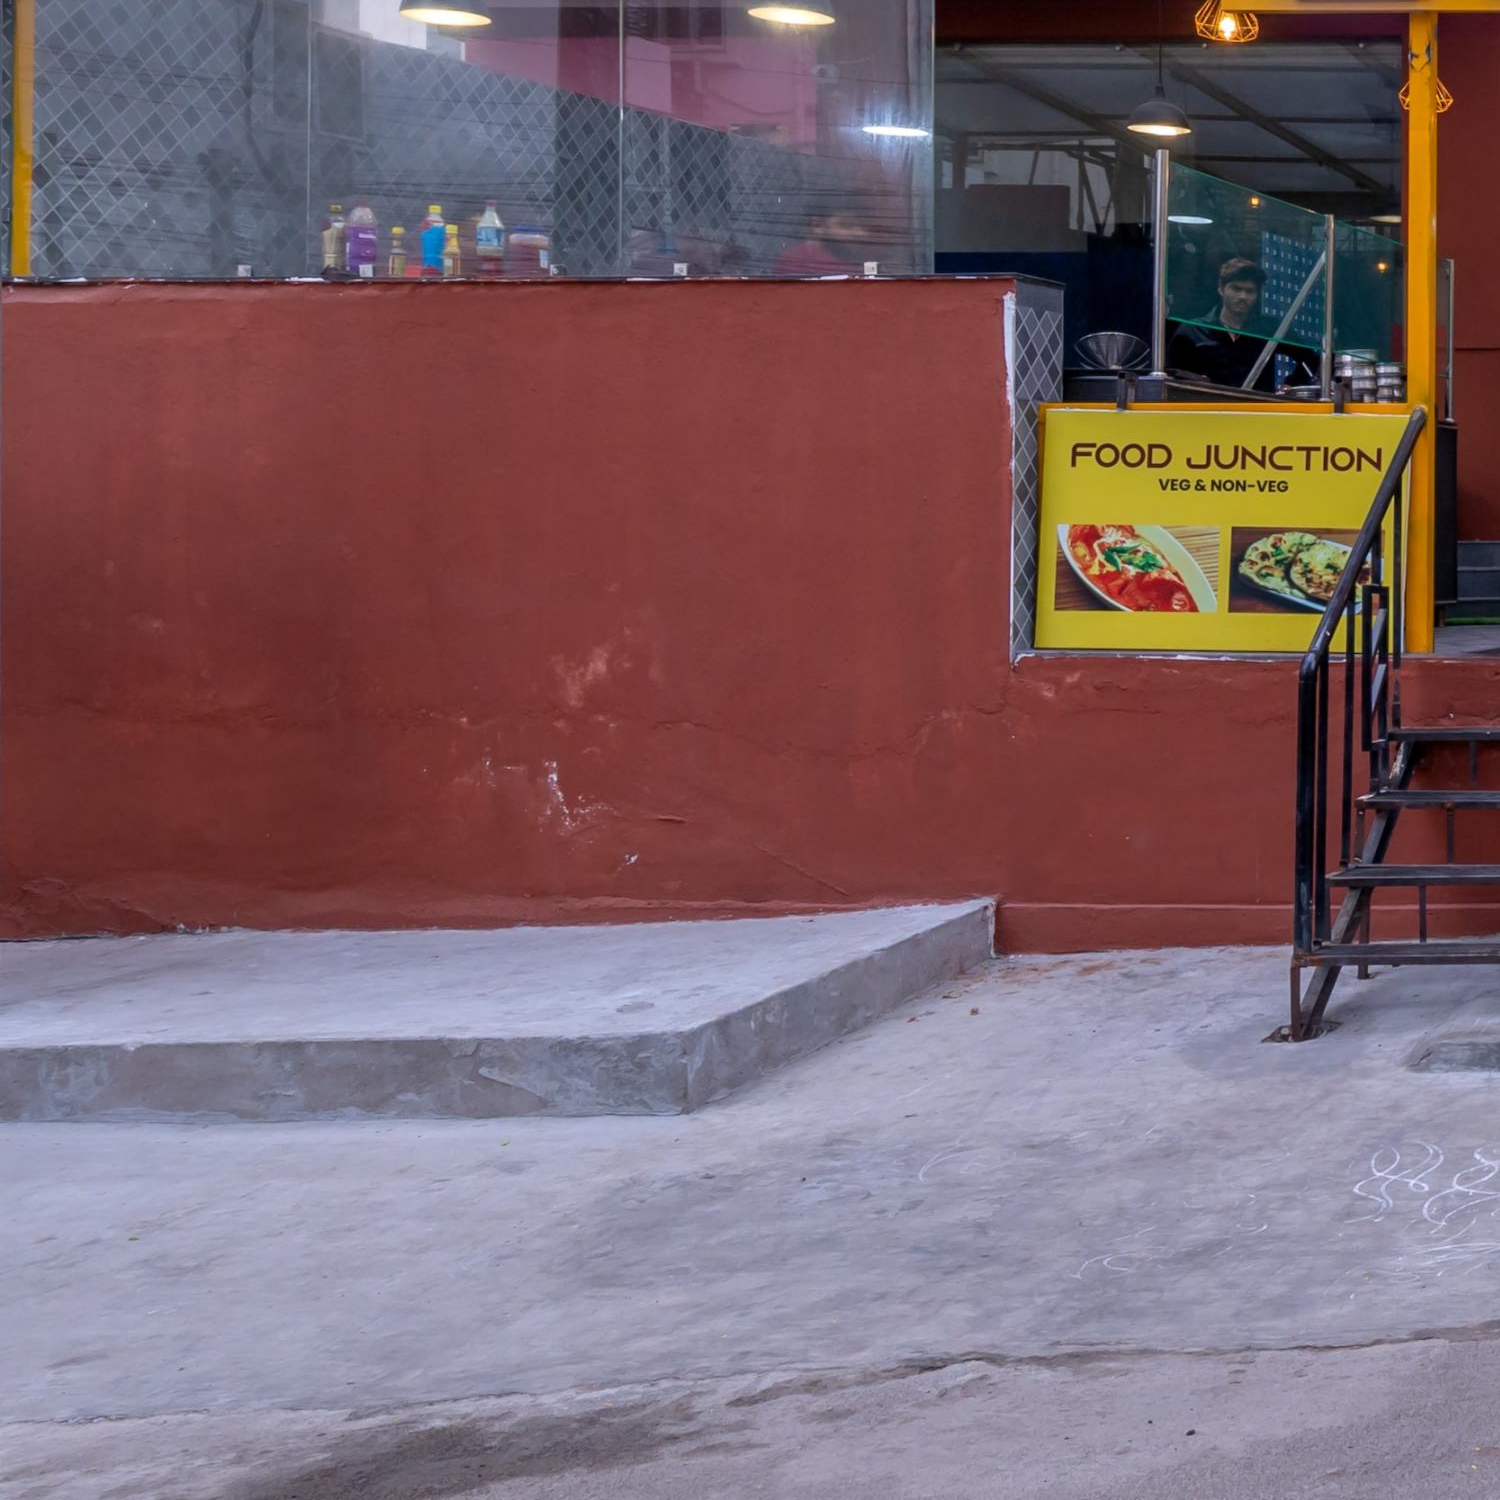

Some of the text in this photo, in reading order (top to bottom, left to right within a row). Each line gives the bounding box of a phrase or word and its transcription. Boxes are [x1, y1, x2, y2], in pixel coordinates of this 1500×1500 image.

[1071, 443, 1383, 472] FOOD JUNCTION
[1158, 478, 1289, 493] VEG & NON-VEG
